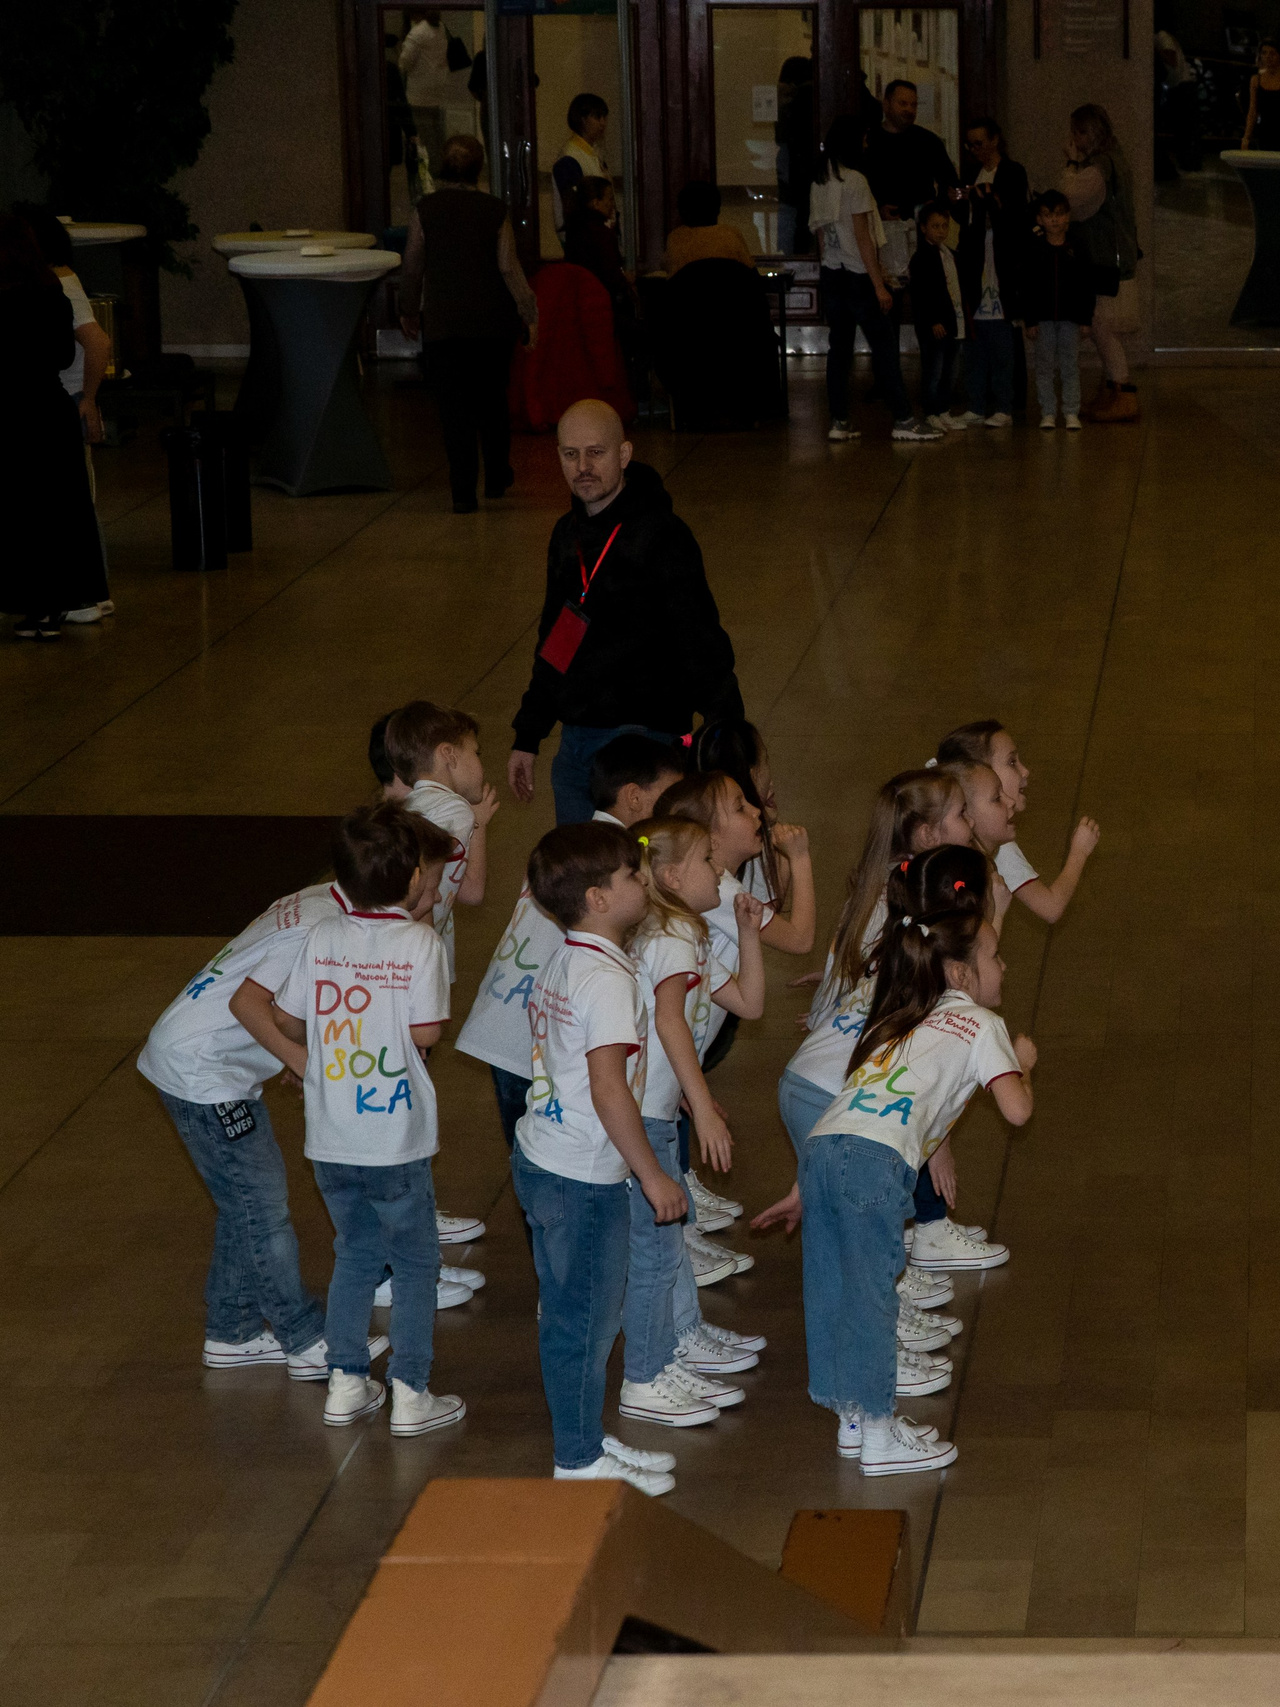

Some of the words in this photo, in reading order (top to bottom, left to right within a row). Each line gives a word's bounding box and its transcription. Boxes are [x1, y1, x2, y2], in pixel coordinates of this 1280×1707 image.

[314, 955, 350, 969] hildren's
[351, 961, 385, 971] musical
[354, 971, 390, 985] Moscow,
[485, 966, 535, 1010] KA
[315, 979, 372, 1016] DO
[323, 1018, 363, 1047] MI
[943, 1010, 981, 1029] theatre
[944, 1017, 977, 1038] Russia
[325, 1046, 407, 1081] SOL
[356, 1079, 412, 1114] KA
[848, 1088, 914, 1126] KA
[221, 1115, 231, 1126] IS
[232, 1103, 248, 1121] NOT
[225, 1116, 255, 1138] OVER
